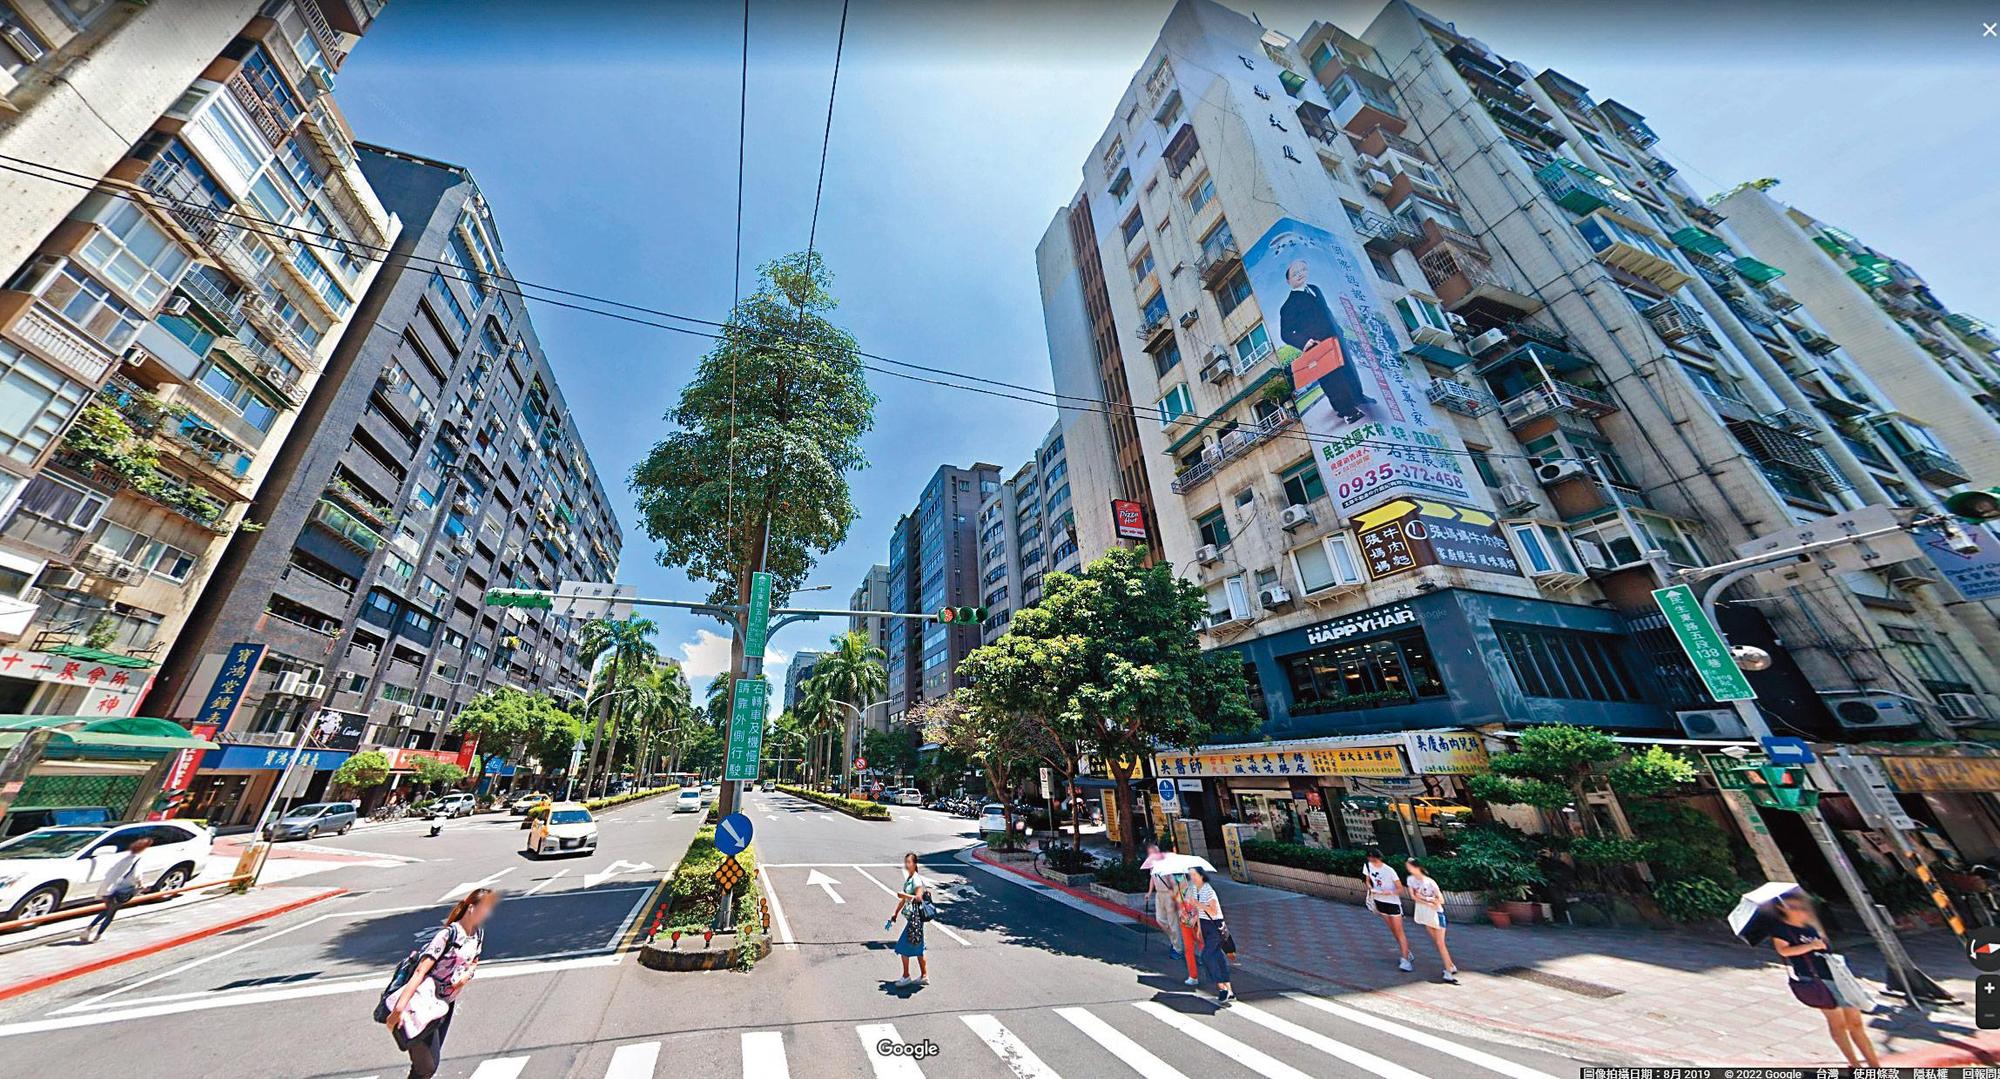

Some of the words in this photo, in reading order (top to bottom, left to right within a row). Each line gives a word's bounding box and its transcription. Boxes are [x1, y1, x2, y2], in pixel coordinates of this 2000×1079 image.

[1338, 463, 1463, 499] 0935-372-458
[1119, 510, 1139, 520] Pizza
[1124, 517, 1137, 525] Hut
[1383, 528, 1412, 567] 牛肉麵
[1429, 524, 1510, 551] 張媽媽牛肉麵
[1365, 535, 1392, 572] 張媽媽
[1306, 603, 1410, 633] PROFESSIONAL
[1308, 610, 1416, 645] HAPPYHAIR
[97, 694, 121, 712] 神
[729, 682, 749, 777] 請靠外側行駛
[745, 682, 763, 777] 右轉車及機慢車
[264, 750, 320, 767] 寶鴻鐘表
[1160, 757, 1203, 775] 吳醫師
